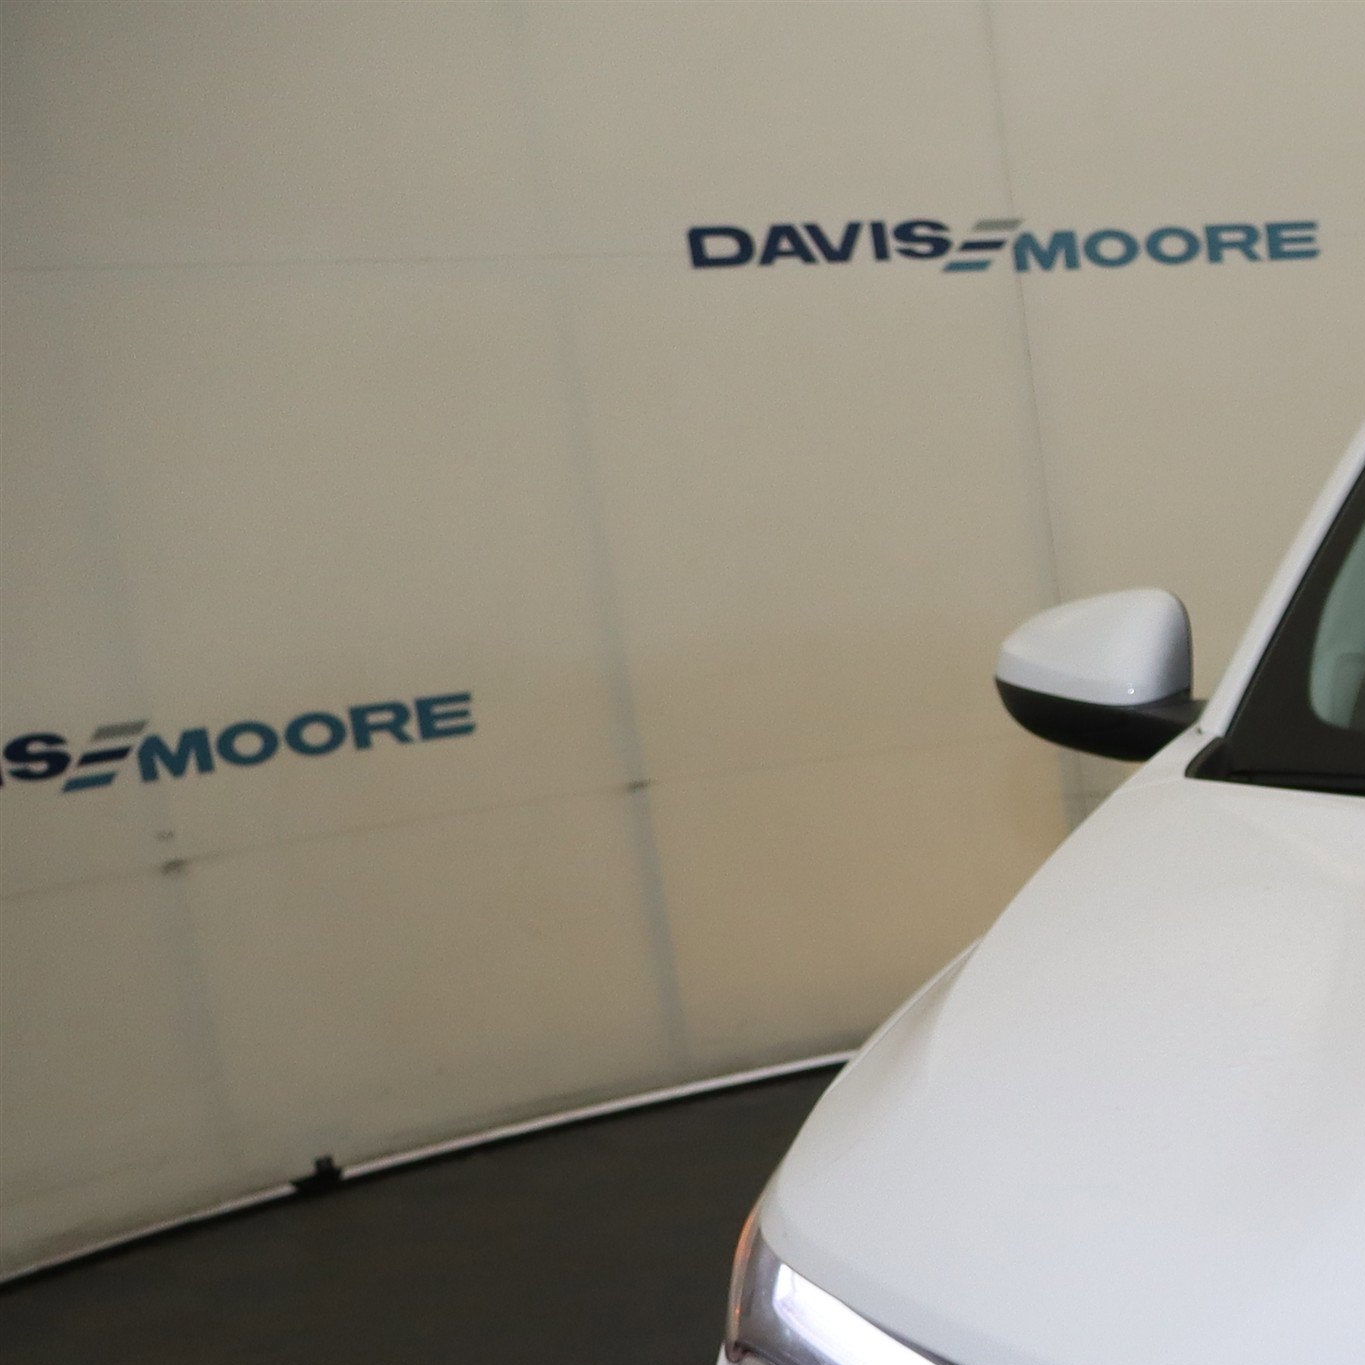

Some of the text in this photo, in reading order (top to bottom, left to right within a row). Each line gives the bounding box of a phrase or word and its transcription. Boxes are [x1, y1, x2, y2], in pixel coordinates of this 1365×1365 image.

[686, 219, 1320, 273] DAVIS MOORE
[136, 692, 476, 783] MOORE
